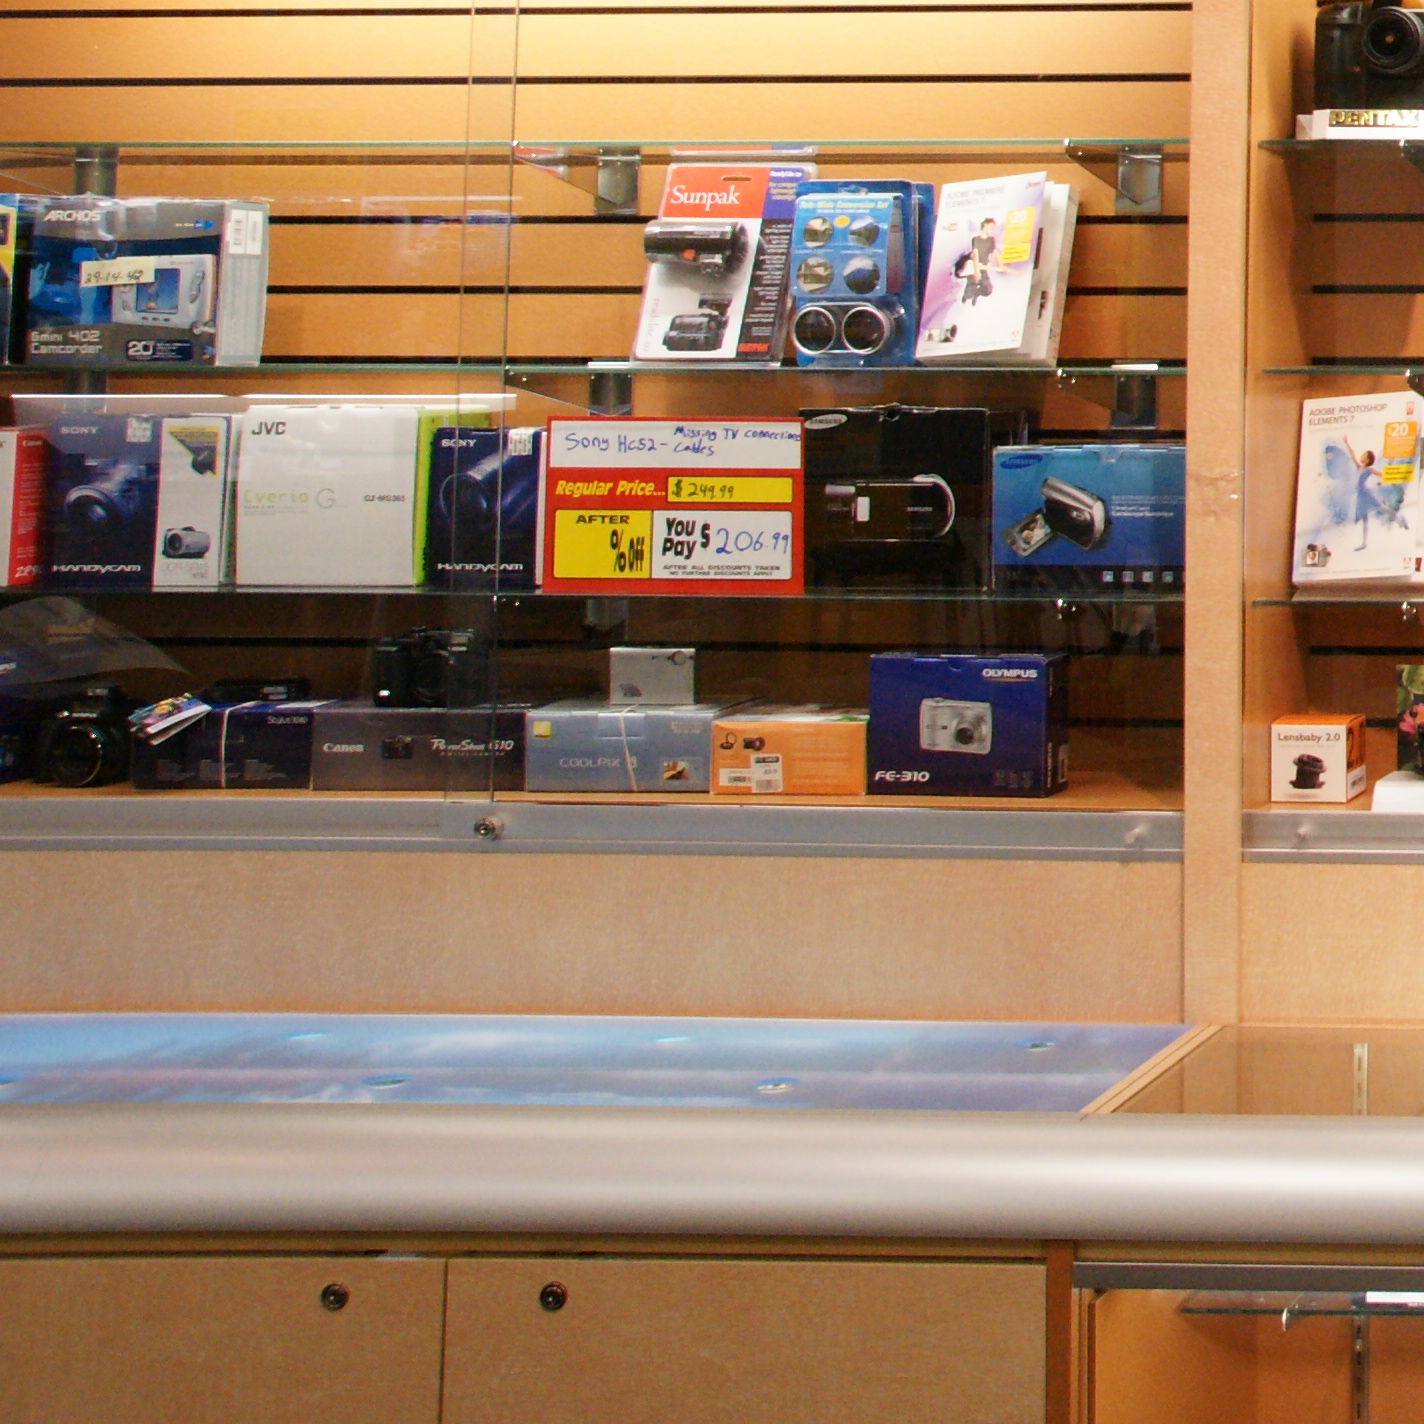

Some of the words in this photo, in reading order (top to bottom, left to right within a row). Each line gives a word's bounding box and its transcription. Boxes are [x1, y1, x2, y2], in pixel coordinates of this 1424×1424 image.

[1329, 110, 1418, 127] PENTAX
[670, 185, 740, 212] Sunpak
[44, 209, 101, 222] ARCHOS
[31, 343, 102, 355] Camcorder
[252, 421, 286, 436] JVC
[565, 432, 610, 453] Sony
[556, 480, 613, 498] Regular
[575, 514, 631, 525] AFTER
[662, 537, 697, 560] Pay
[982, 668, 1038, 679] OLYMPUS
[323, 743, 364, 753] Canon
[559, 757, 621, 768] COOLPIX
[874, 771, 930, 782] FE-310
